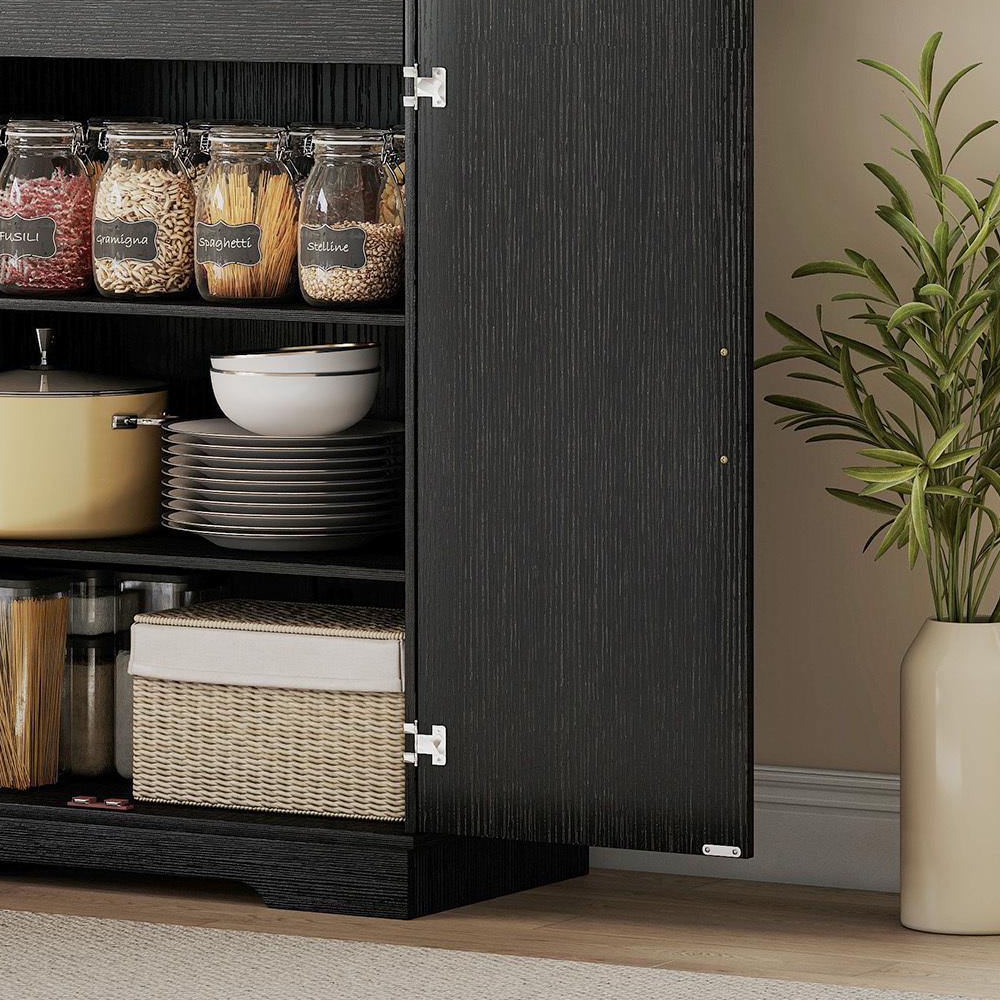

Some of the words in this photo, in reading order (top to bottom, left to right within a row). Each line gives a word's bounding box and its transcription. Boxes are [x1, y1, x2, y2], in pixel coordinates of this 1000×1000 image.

[96, 233, 149, 248] Gramigna
[198, 236, 253, 251] Spaghetti
[306, 240, 350, 252] Stelline
